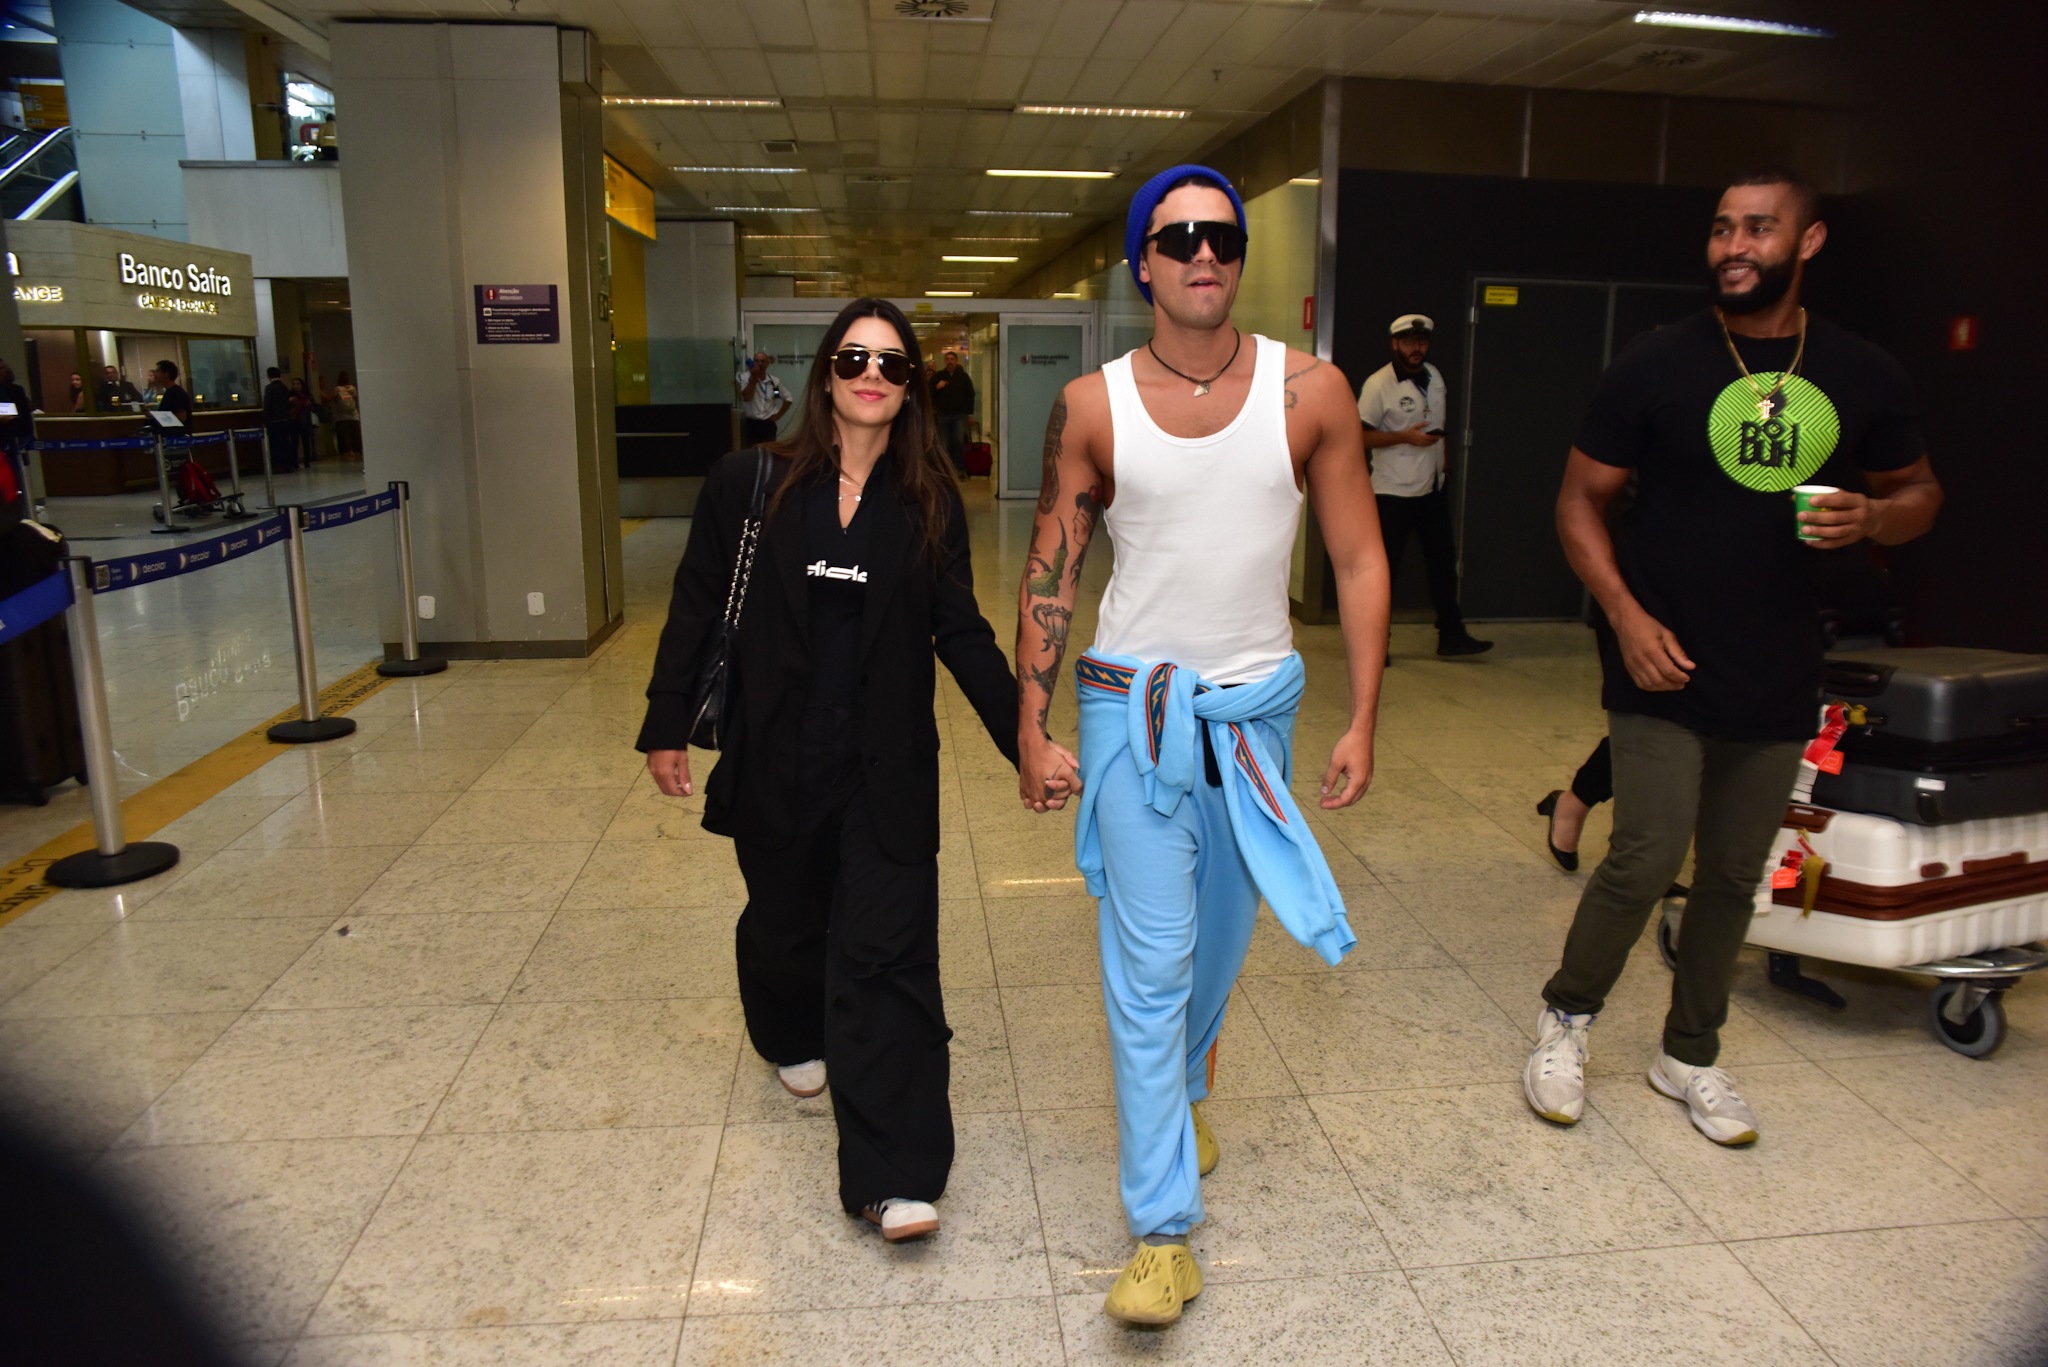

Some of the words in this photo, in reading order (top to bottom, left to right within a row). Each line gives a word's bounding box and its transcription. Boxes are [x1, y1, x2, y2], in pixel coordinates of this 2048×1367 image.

[119, 252, 184, 290] Banco
[186, 263, 232, 296] Safra
[13, 285, 63, 302] ANGE
[265, 525, 282, 538] decolar
[230, 537, 249, 551] decolar
[190, 550, 211, 564] decolar
[142, 560, 167, 574] decolar
